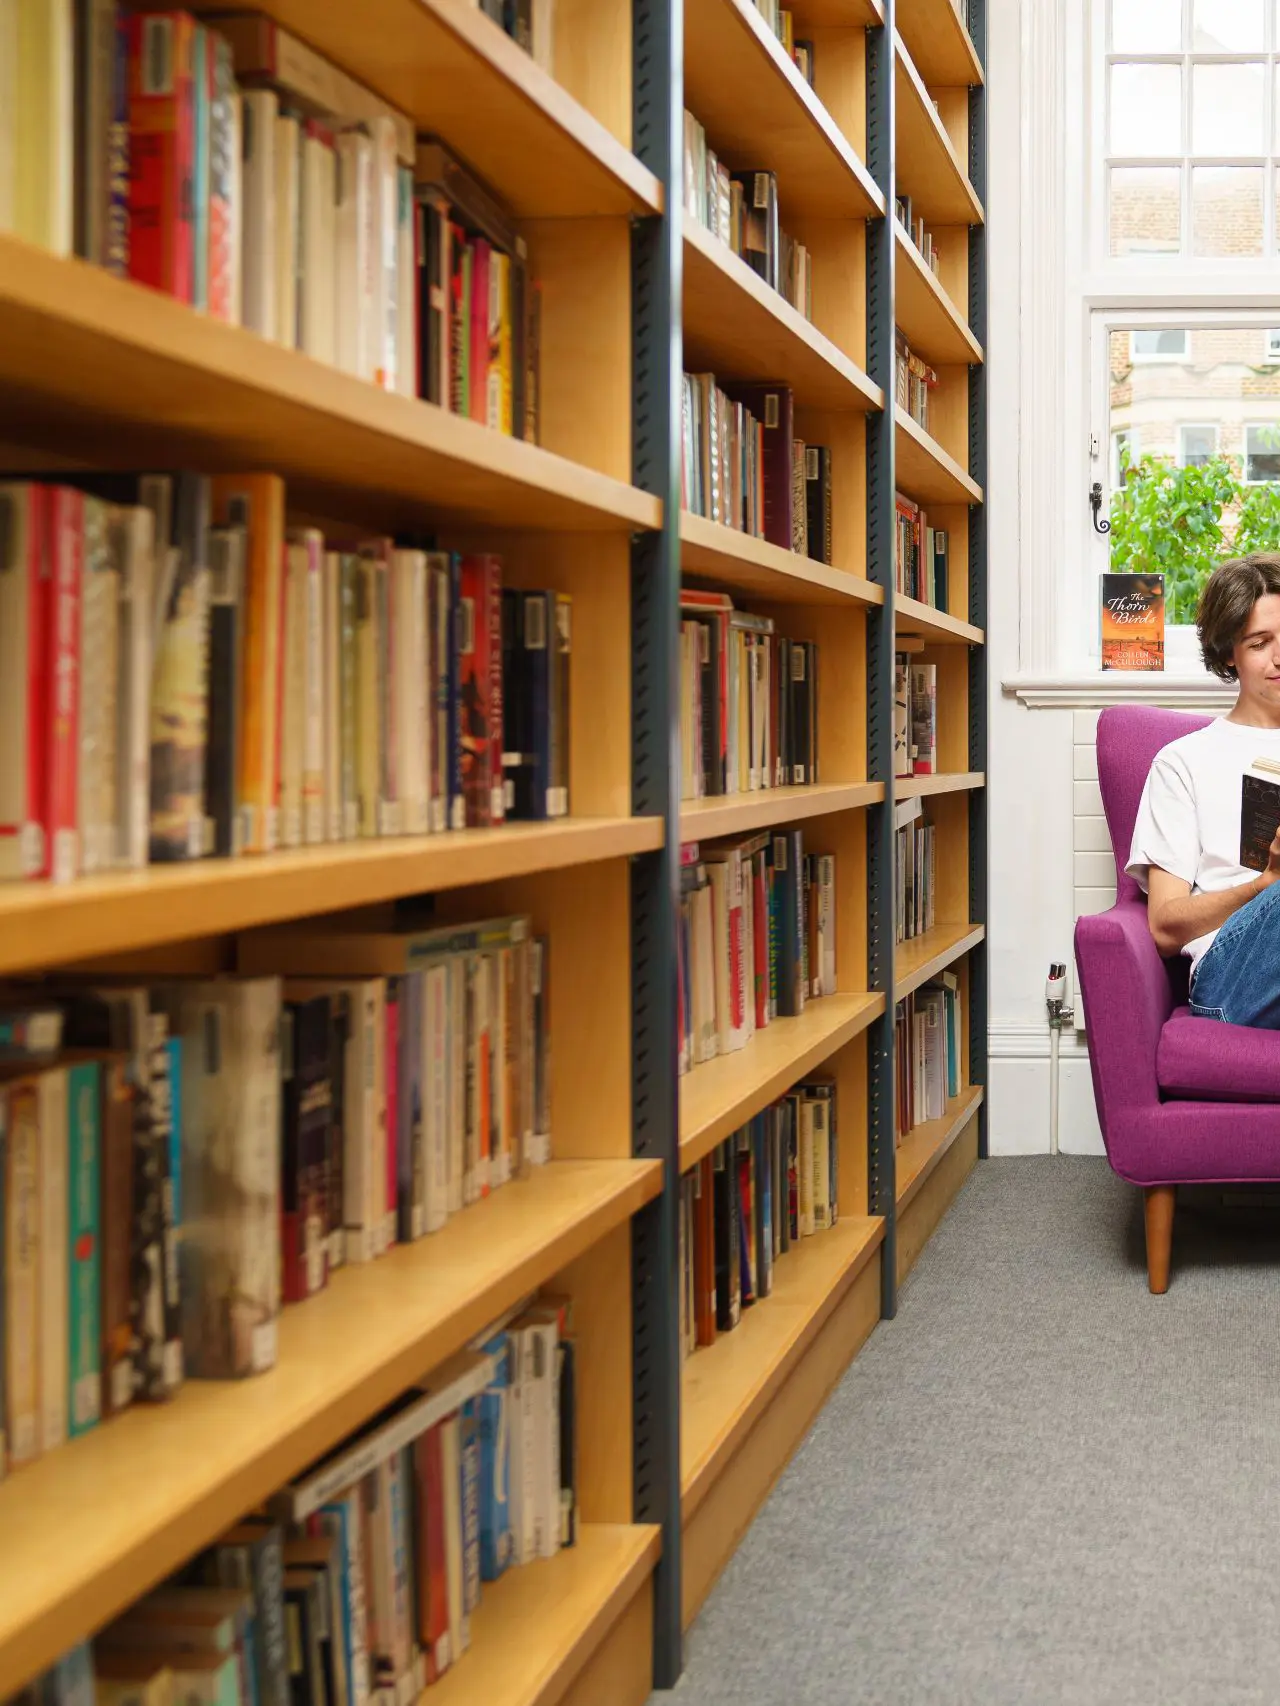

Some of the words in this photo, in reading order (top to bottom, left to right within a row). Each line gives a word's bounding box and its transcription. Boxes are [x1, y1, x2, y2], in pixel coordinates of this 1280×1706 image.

[1107, 596, 1150, 611] Thorn
[1130, 592, 1145, 601] The
[1111, 610, 1157, 624] Birds
